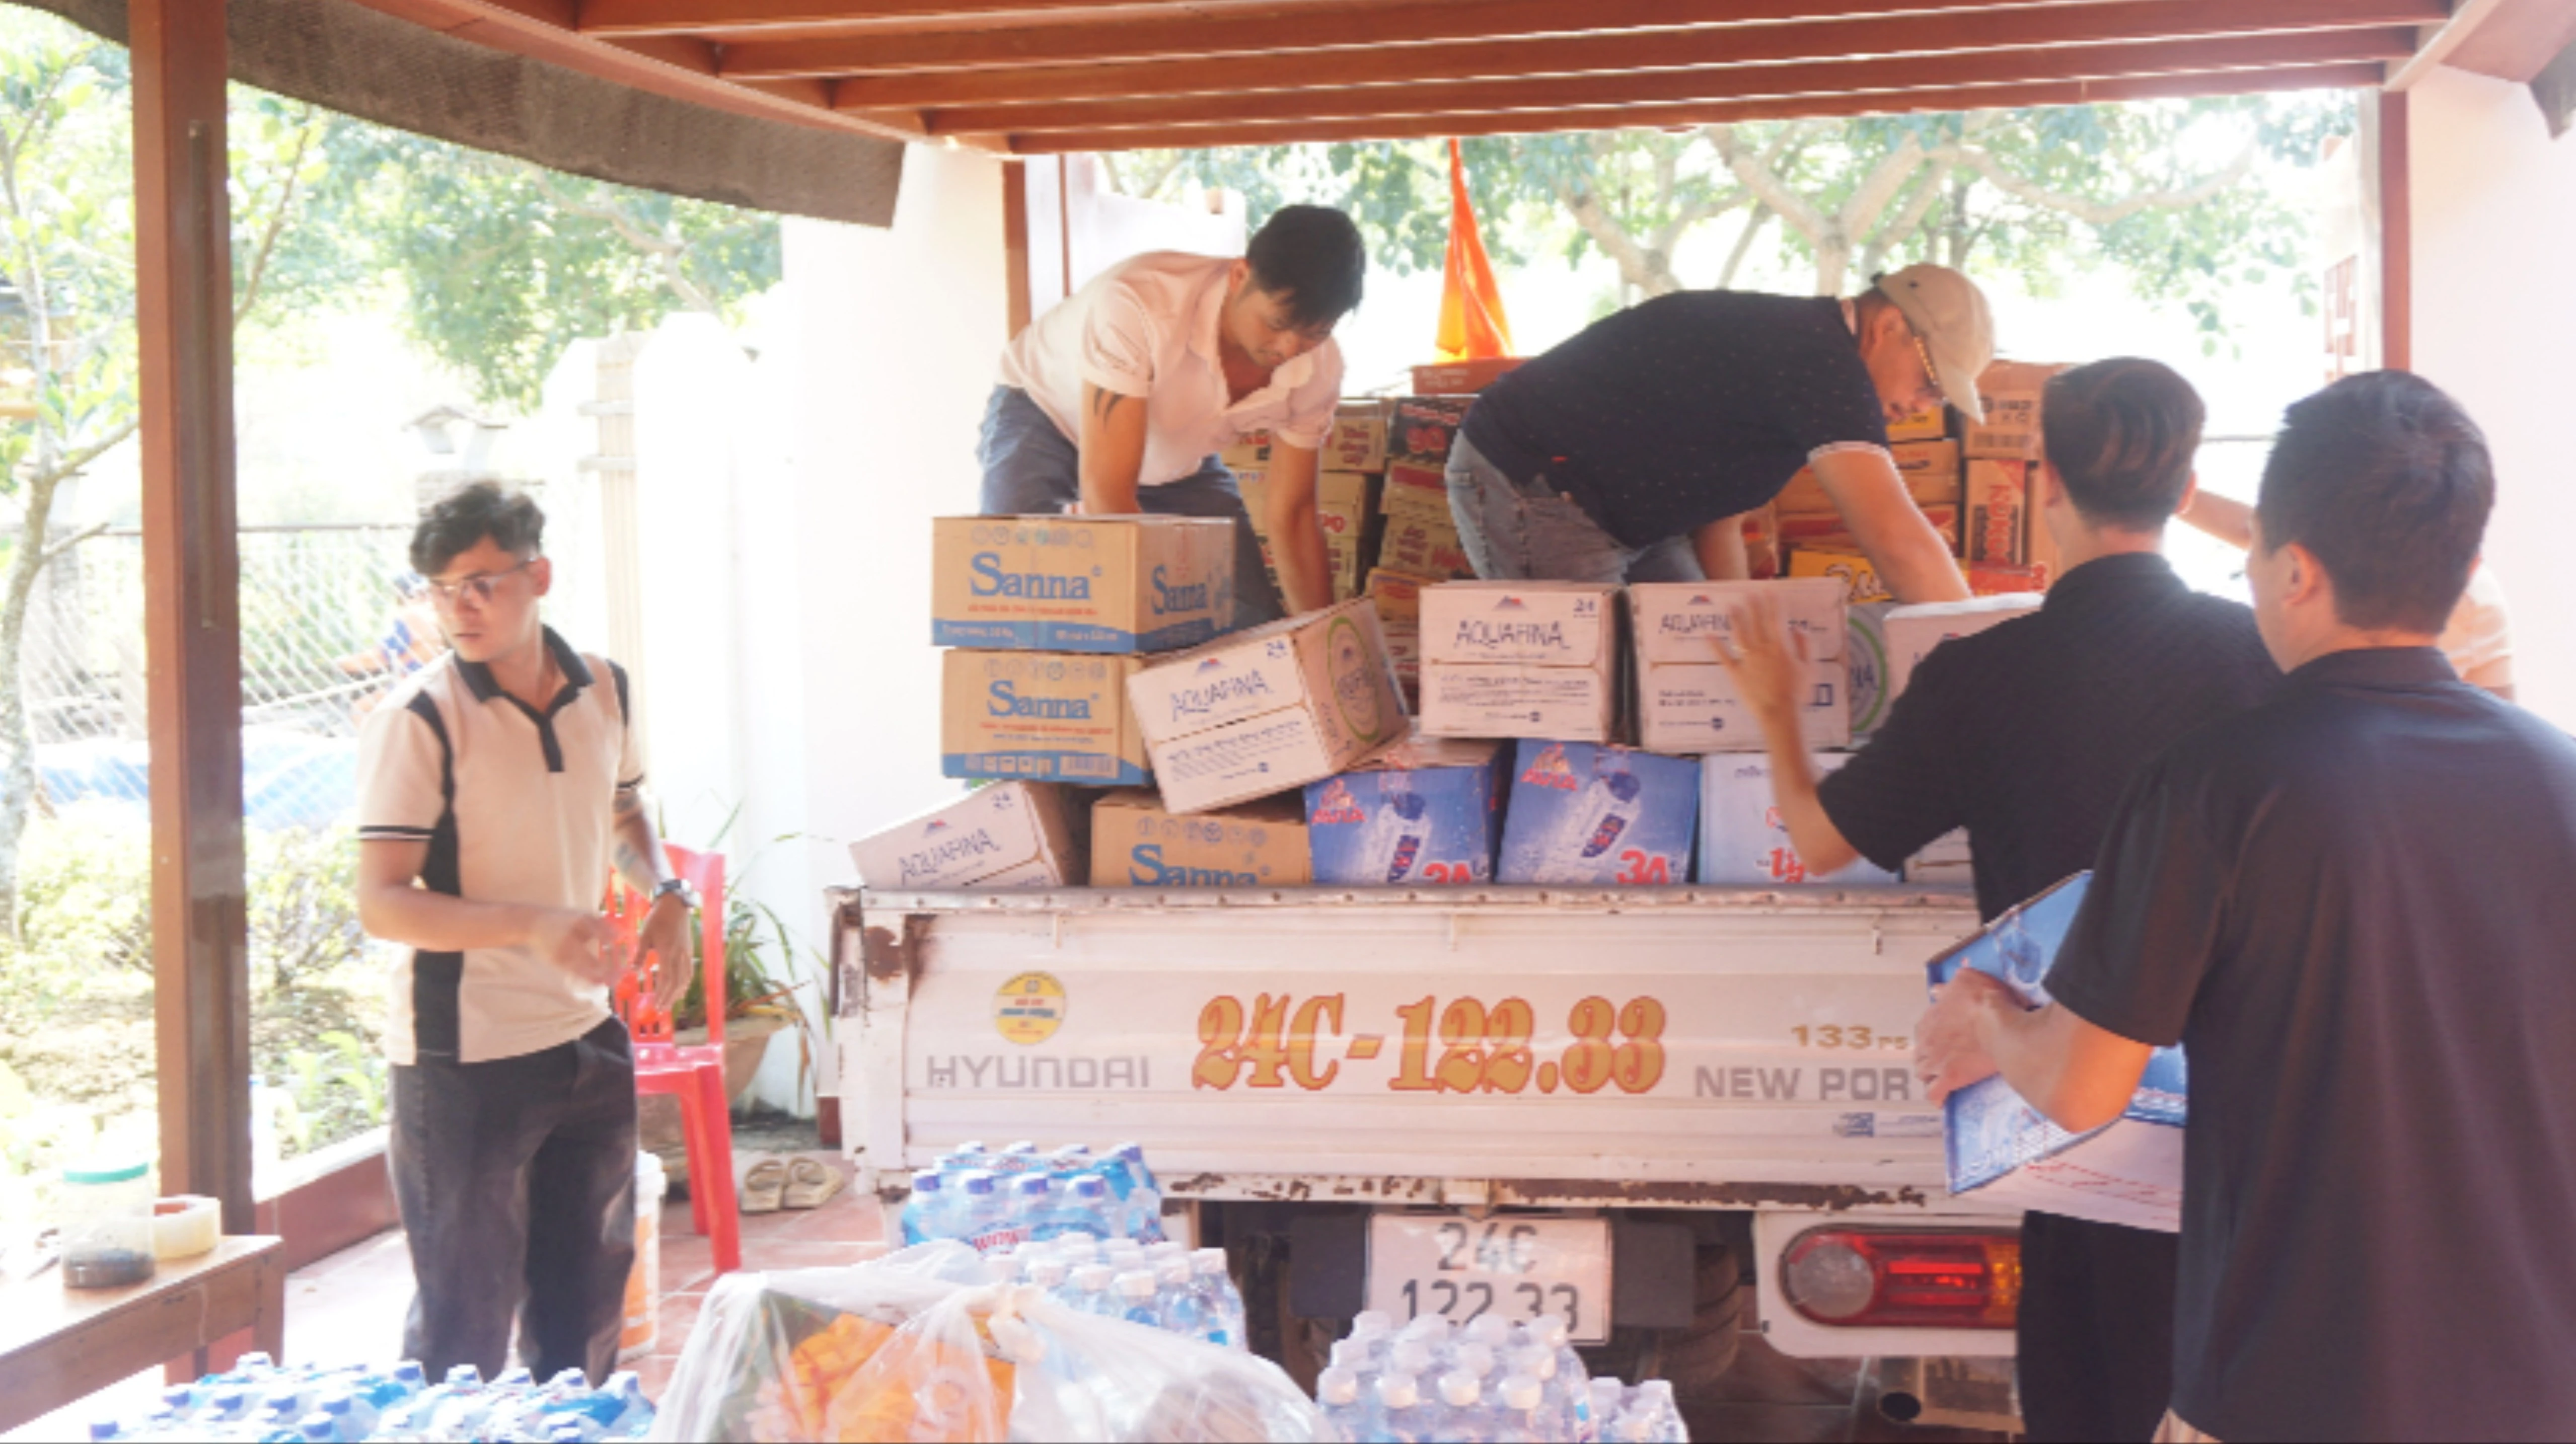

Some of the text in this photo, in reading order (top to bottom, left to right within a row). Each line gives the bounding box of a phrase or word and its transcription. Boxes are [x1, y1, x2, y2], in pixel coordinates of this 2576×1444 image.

[969, 552, 1090, 599] Sanna
[1454, 620, 1572, 649] AQUAFINA
[987, 679, 1091, 719] Sanna
[1169, 667, 1275, 722] AQUAFINA
[899, 828, 1001, 886] AQUAFINA
[1191, 992, 1667, 1094] 24C-122.33
[1791, 1024, 1873, 1049] 133
[926, 1055, 1150, 1089] HYUNDAI
[1695, 1066, 1802, 1098] NEW
[1438, 1222, 1538, 1273] 24C
